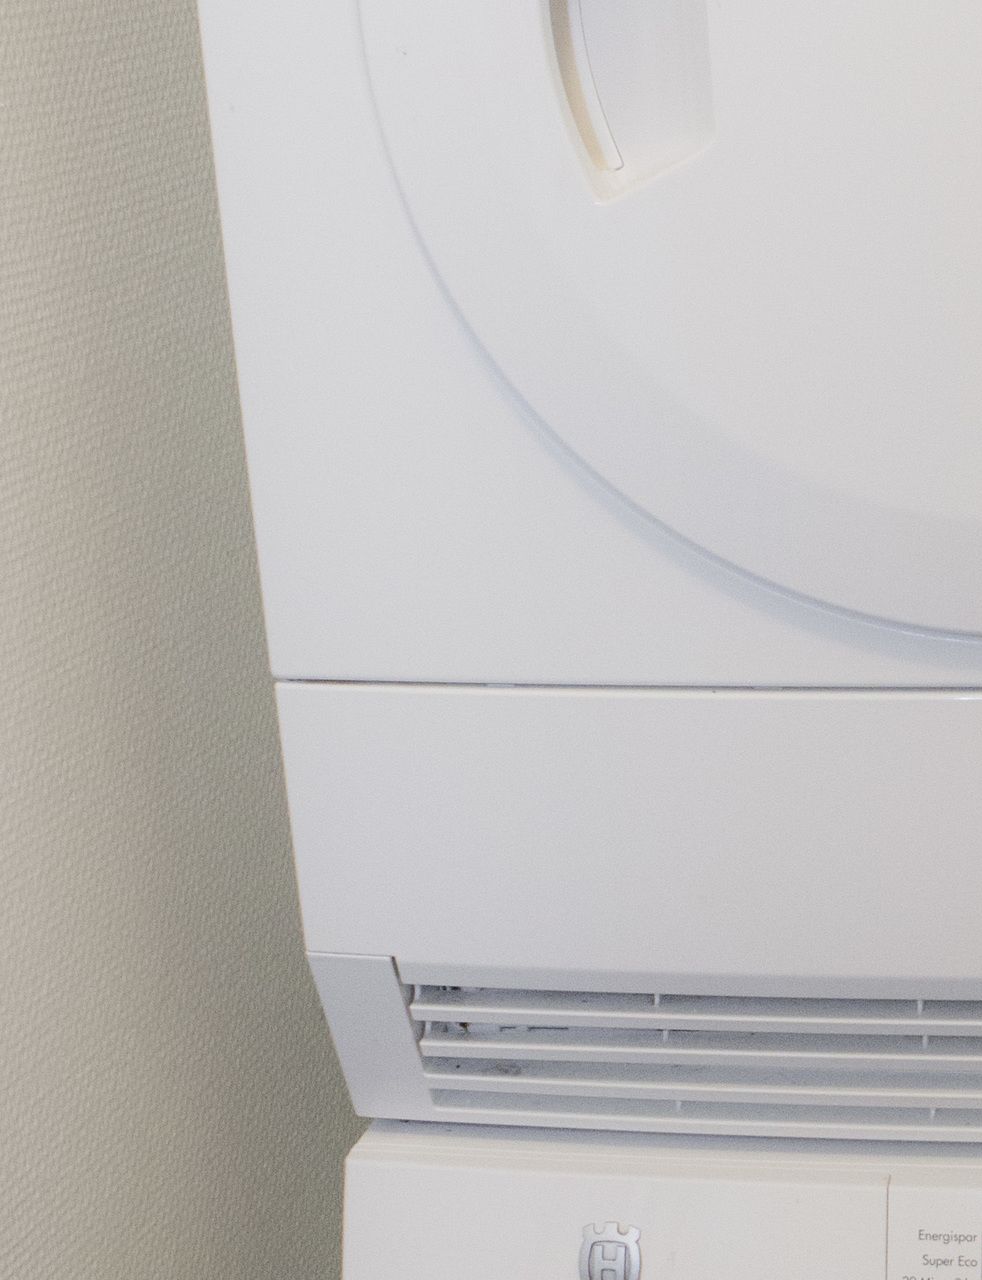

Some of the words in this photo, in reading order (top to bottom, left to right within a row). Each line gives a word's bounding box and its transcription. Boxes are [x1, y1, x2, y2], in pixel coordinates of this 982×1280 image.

[918, 1230, 978, 1244] Energispar
[922, 1255, 953, 1268] Super
[958, 1256, 978, 1267] Eco
